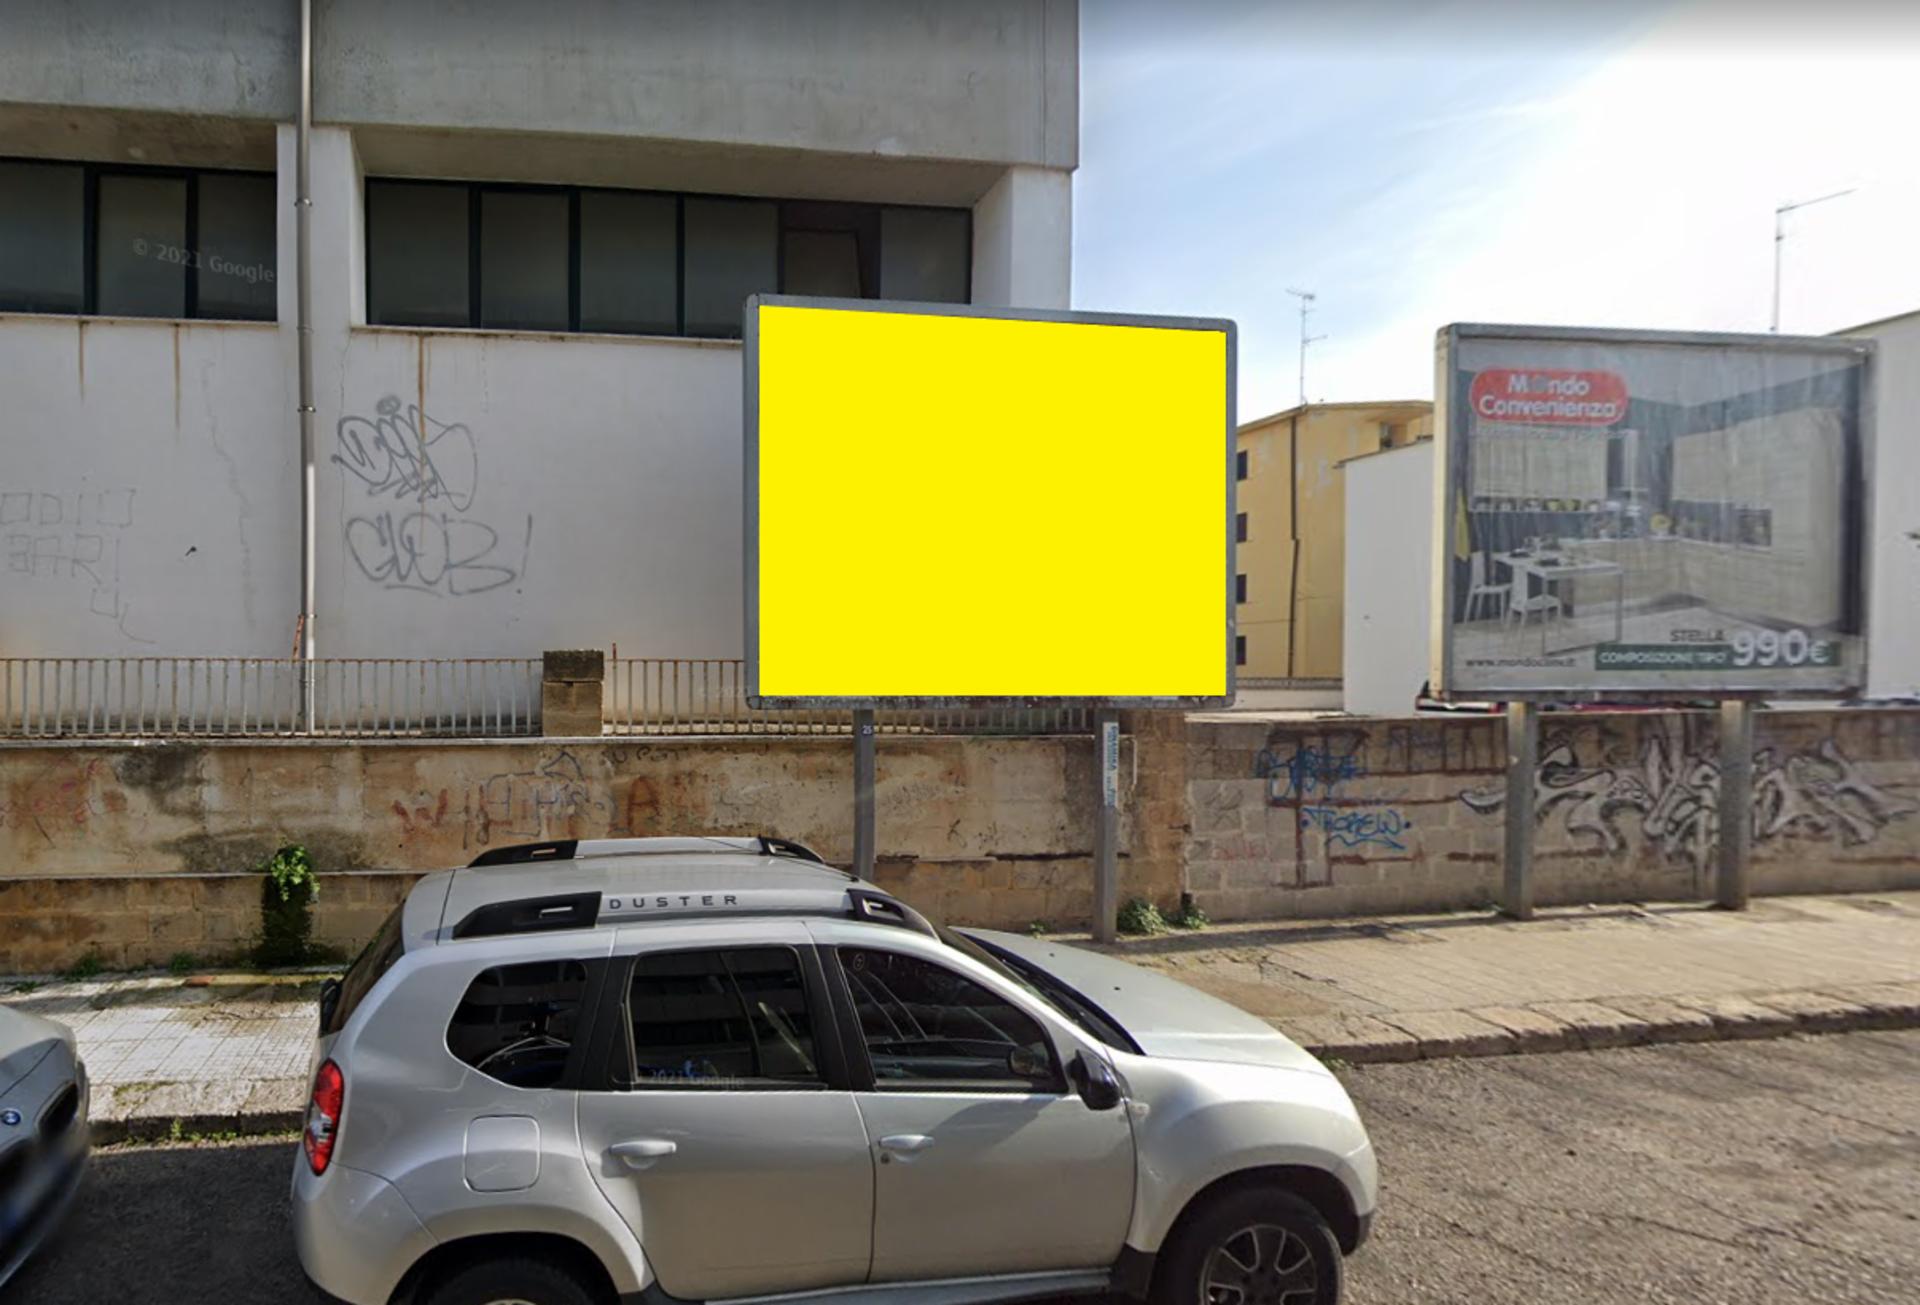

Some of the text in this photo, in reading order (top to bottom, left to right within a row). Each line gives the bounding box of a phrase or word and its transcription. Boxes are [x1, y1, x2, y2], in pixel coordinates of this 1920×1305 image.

[1507, 373, 1590, 396] Mondo
[1478, 394, 1617, 418] Convenienza
[1669, 629, 1726, 643] STELLA
[609, 895, 737, 910] DUSTER
